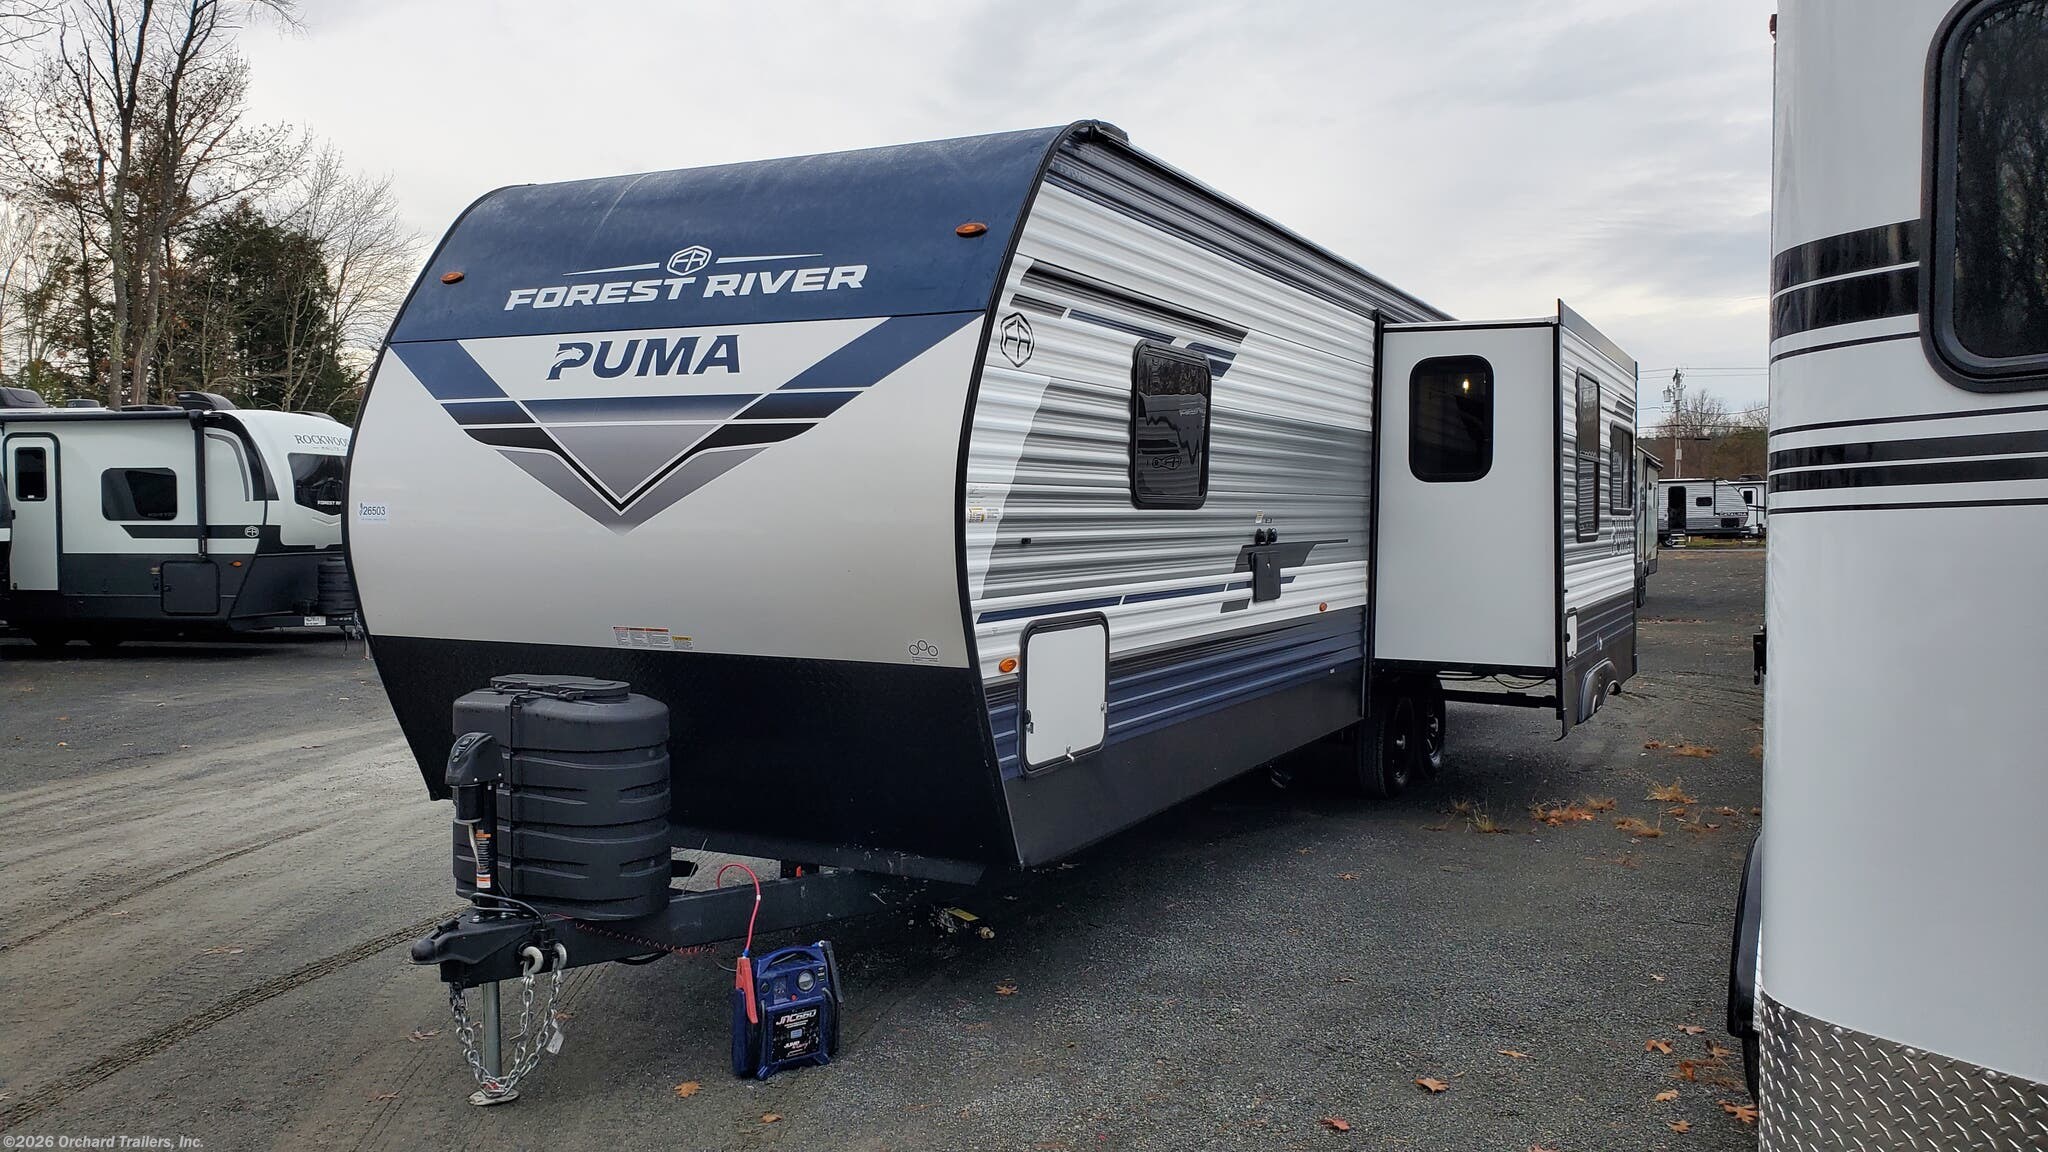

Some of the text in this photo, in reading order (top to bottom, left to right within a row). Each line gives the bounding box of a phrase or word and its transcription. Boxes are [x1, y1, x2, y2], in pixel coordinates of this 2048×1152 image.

[504, 265, 867, 311] FOREST RIVER
[546, 334, 740, 381] PUMA
[294, 434, 348, 446] ROCKWOO
[362, 506, 386, 516] 26503
